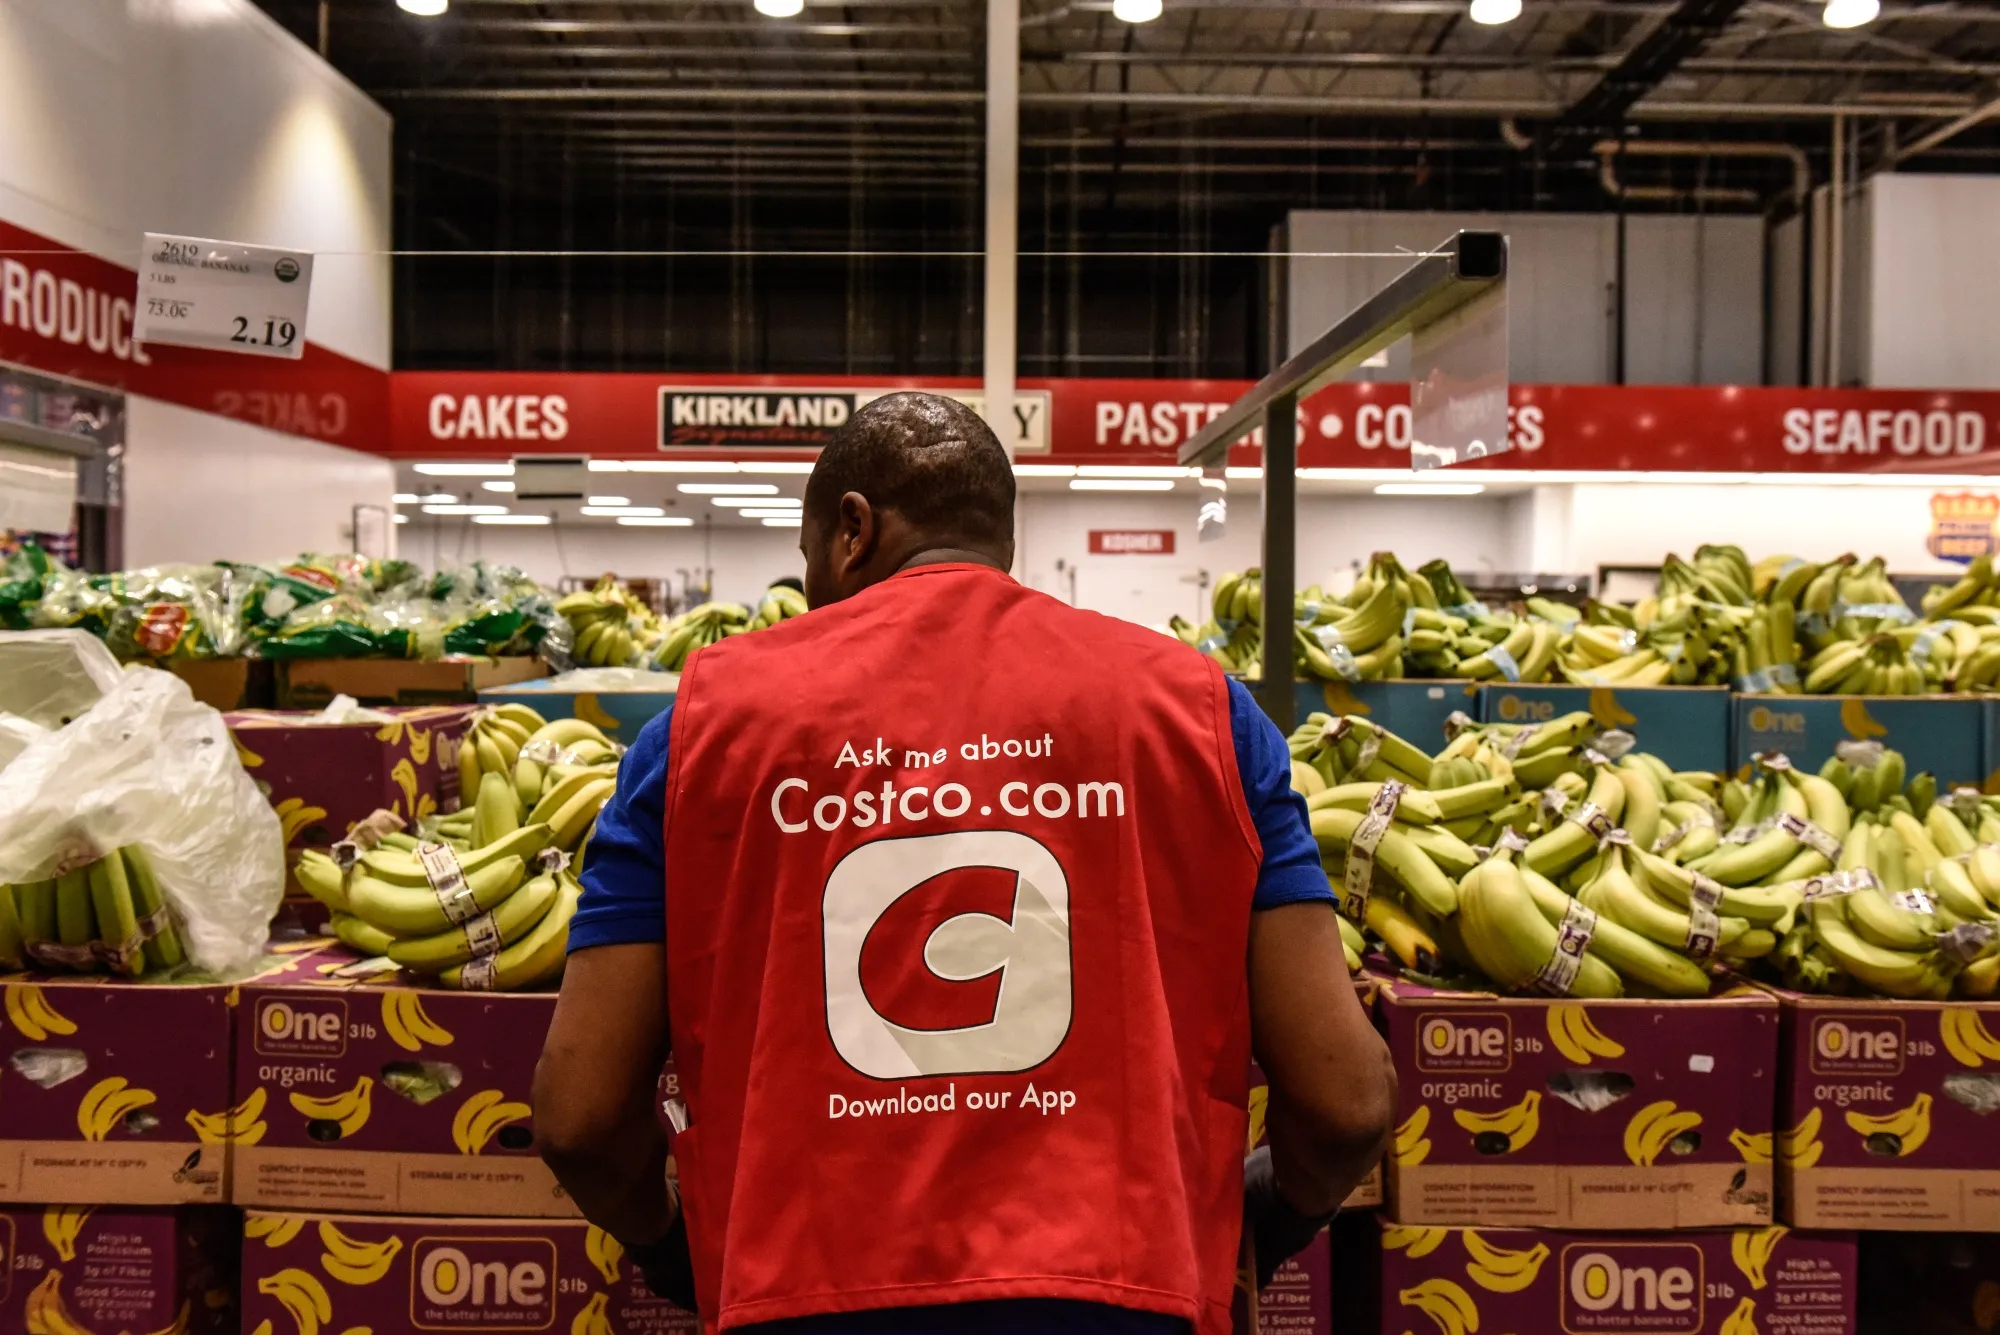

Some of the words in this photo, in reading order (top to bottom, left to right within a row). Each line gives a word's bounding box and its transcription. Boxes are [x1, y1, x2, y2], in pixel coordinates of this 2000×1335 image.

[161, 241, 199, 257] 2619
[152, 254, 196, 267] ORGANIC
[201, 259, 250, 273] BANANAS
[157, 274, 176, 284] LBS
[0, 258, 152, 366] RODUC
[231, 315, 296, 348] 2.19
[428, 394, 569, 440] CAKES
[672, 396, 848, 427] KIRKLAND
[1782, 407, 1985, 455] SEAFOOD
[1102, 533, 1163, 551] KOSHER
[1499, 694, 1554, 721] One
[1747, 705, 1806, 733] One
[834, 738, 892, 769] Ask
[904, 747, 948, 769] me
[960, 733, 1054, 762] about
[771, 777, 1125, 834] Costco.com
[261, 1002, 341, 1042] One
[348, 1024, 377, 1040] 3lb
[1422, 1019, 1504, 1057] One
[1817, 1021, 1898, 1060] One
[1513, 1037, 1544, 1053] 3lb
[1906, 1040, 1936, 1057] 3lb
[259, 1063, 338, 1088] organic
[1421, 1078, 1502, 1104] organic
[1814, 1080, 1894, 1107] organic
[829, 1083, 956, 1119] Download
[966, 1091, 1012, 1111] our
[1019, 1083, 1077, 1116] App
[259, 1164, 300, 1173] CONTACT
[303, 1166, 364, 1176] INFORMATION
[410, 1171, 453, 1180] STORAGE
[1423, 1183, 1466, 1192] CONTACT
[1469, 1183, 1534, 1192] INFORMATION
[1816, 1186, 1859, 1195] CONTACT
[1861, 1187, 1927, 1195] INFORMATION
[14, 1254, 44, 1271] 3lb
[1786, 1258, 1816, 1271] High
[1818, 1258, 1832, 1269] in
[102, 1266, 116, 1276] of
[118, 1267, 152, 1277] Fiber
[420, 1247, 546, 1306] One
[1776, 1269, 1841, 1281] Potassium
[558, 1277, 588, 1294] 3lb
[1570, 1252, 1694, 1311] One
[1260, 1293, 1274, 1304] of
[1277, 1293, 1311, 1304] Fiber
[1706, 1282, 1735, 1299] 3lb
[1775, 1292, 1791, 1305] 3g
[1793, 1292, 1807, 1303] of
[1809, 1292, 1842, 1303] Fiber
[425, 1309, 443, 1320] the
[446, 1309, 479, 1321] better
[484, 1309, 524, 1321] banana
[621, 1307, 656, 1319] Good
[1271, 1314, 1316, 1326] Source
[1576, 1315, 1594, 1326] the
[1597, 1315, 1631, 1326] better
[1634, 1315, 1674, 1326] banana
[1766, 1313, 1801, 1325] Good
[1803, 1313, 1847, 1325] Source
[628, 1320, 642, 1330] of
